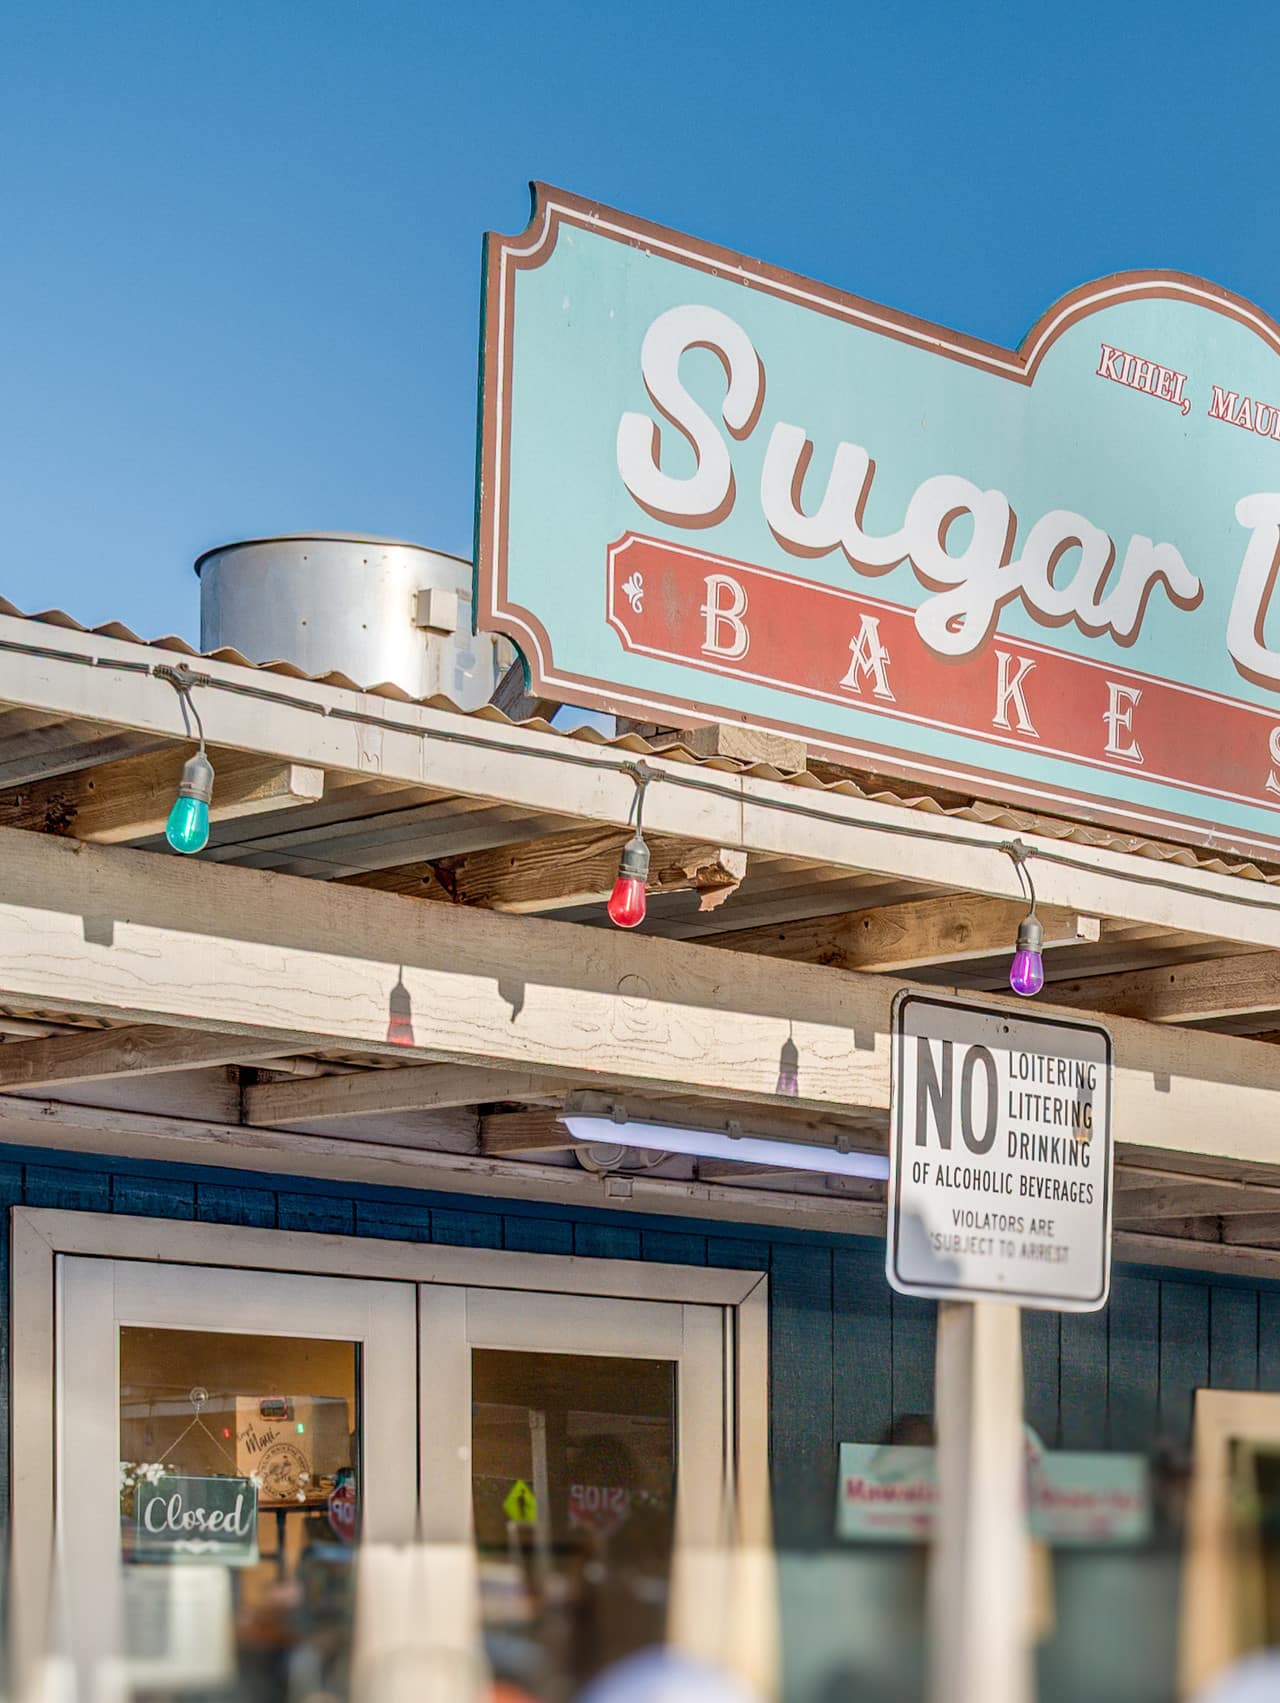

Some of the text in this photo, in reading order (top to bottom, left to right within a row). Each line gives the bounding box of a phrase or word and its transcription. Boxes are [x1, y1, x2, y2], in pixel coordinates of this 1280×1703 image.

[1096, 343, 1191, 416] KIHEI,
[617, 304, 1203, 664] Sugar
[700, 573, 1145, 765] BAKE
[1008, 1051, 1097, 1091] LOITERING
[915, 1036, 999, 1155] NO
[1008, 1091, 1093, 1129] LITTERING
[1007, 1130, 1090, 1168] DRINKING
[912, 1161, 1094, 1205] OF ALCOHOLIC BEVERAGES
[952, 1208, 1055, 1238] VIOLATORS ARE
[932, 1233, 1069, 1265] SUBJECT TO ARREST
[144, 1493, 254, 1537] Closed
